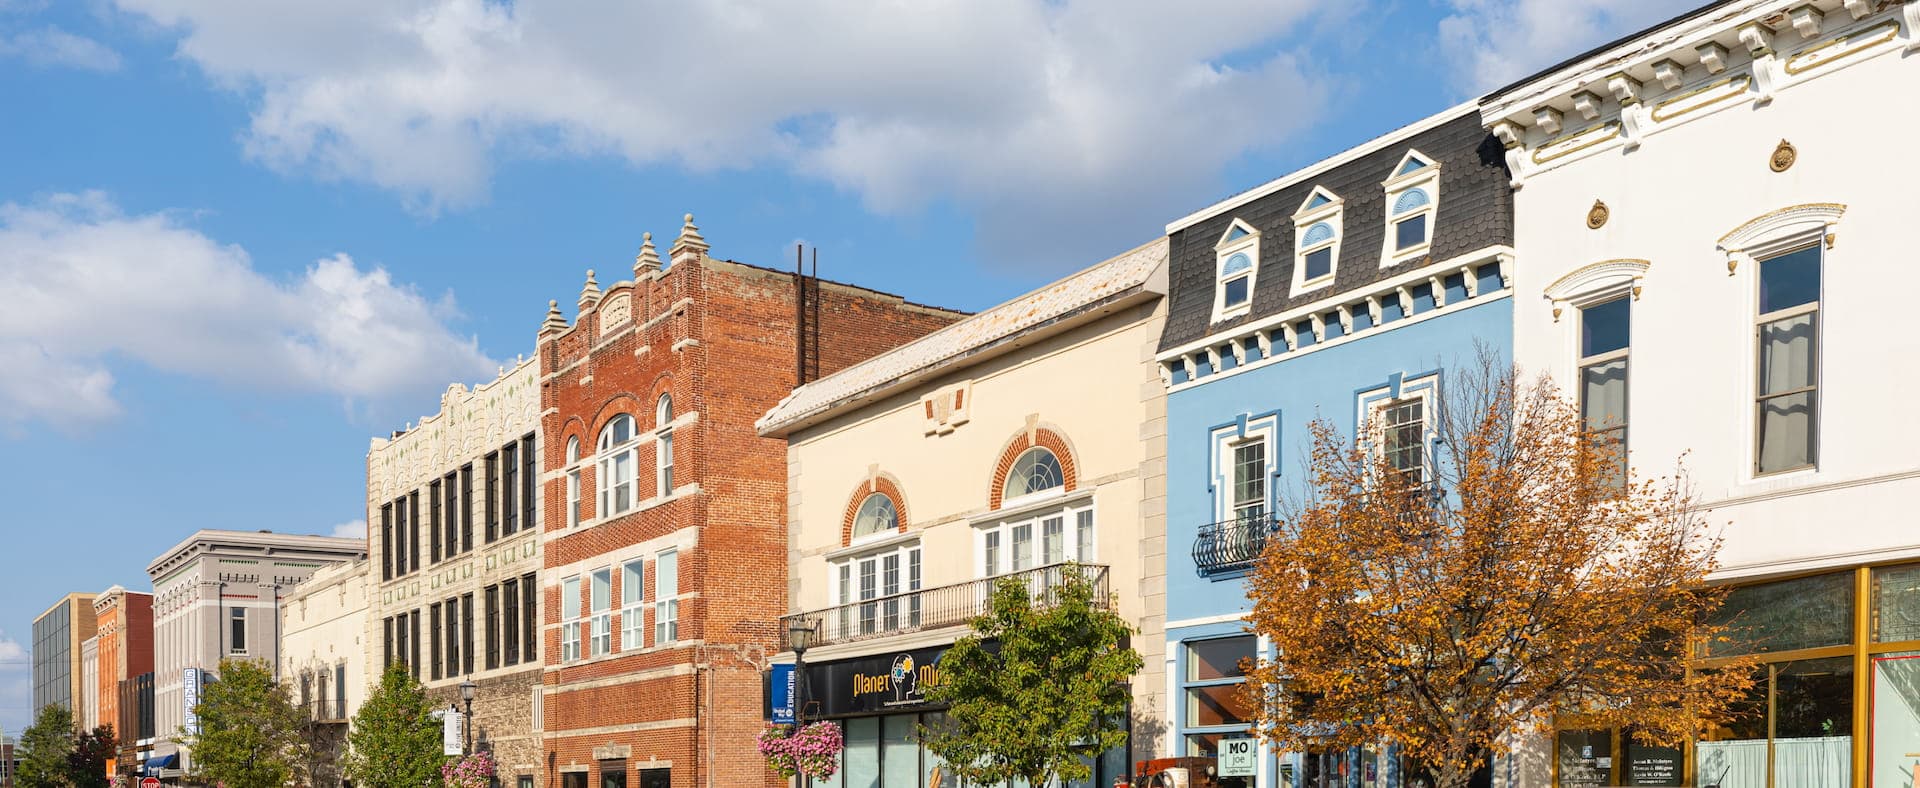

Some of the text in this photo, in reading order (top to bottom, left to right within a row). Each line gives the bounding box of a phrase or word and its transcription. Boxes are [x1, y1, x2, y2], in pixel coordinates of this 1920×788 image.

[787, 670, 795, 708] EDUCATION
[853, 673, 890, 698] Planet
[1229, 742, 1248, 754] MO
